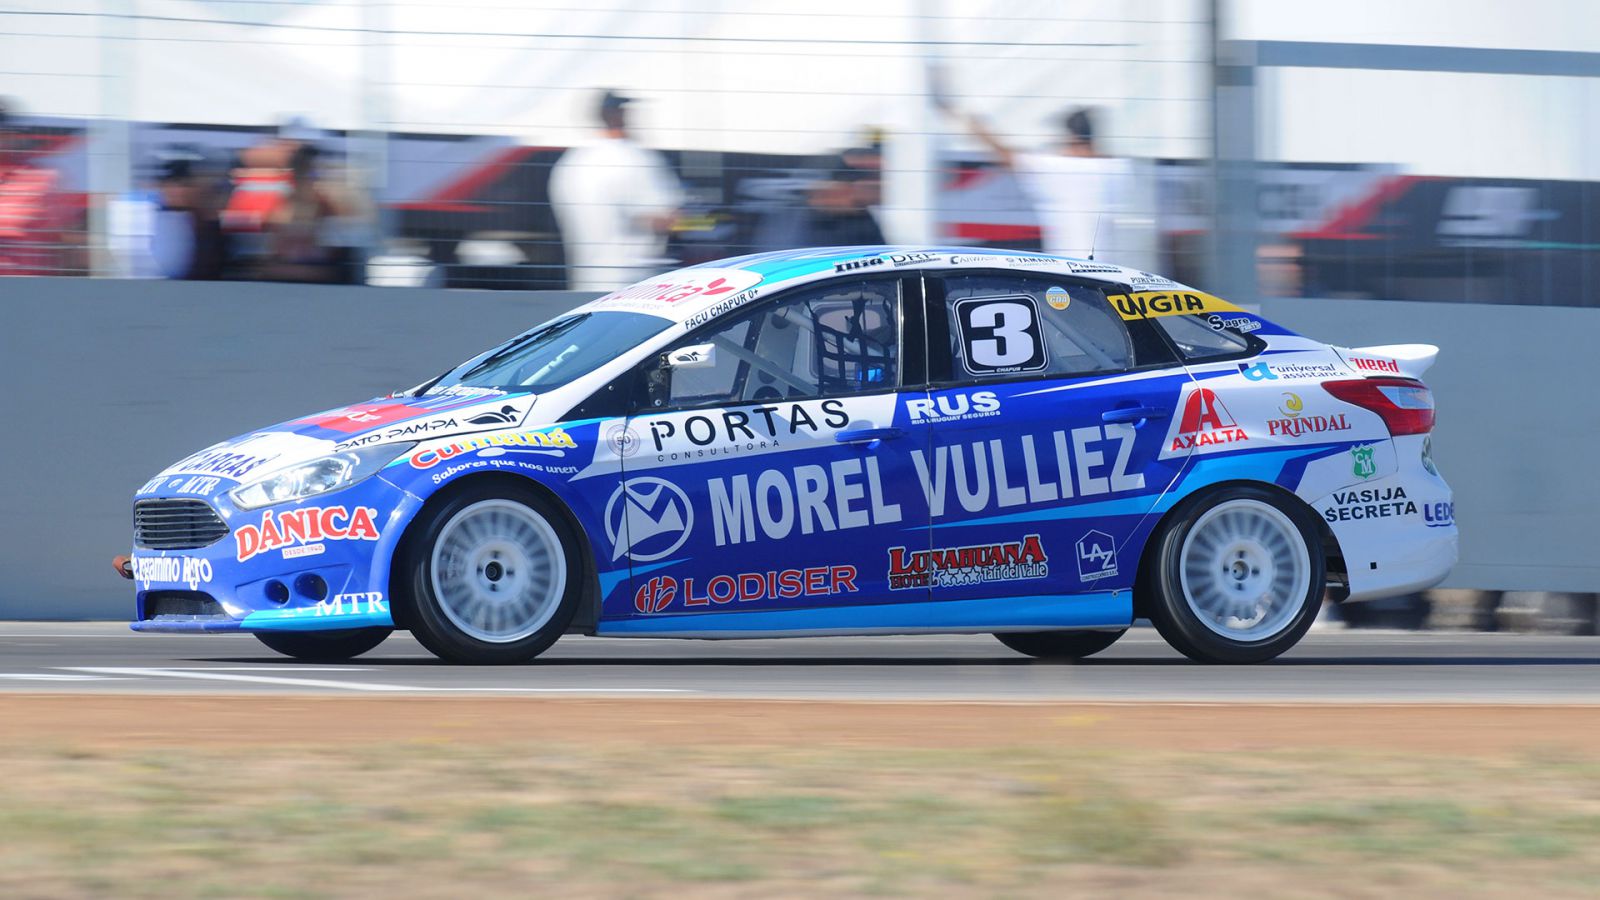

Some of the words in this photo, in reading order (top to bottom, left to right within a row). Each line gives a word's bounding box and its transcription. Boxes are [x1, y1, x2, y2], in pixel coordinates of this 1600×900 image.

[685, 313, 708, 330] FACU
[709, 293, 748, 317] CHAPUR
[1208, 314, 1251, 331] Sagre
[969, 302, 1035, 367] 3
[1276, 363, 1336, 373] universal
[1282, 370, 1350, 380] assistance
[905, 391, 1001, 420] RUS
[926, 415, 961, 424] URUGUAY
[962, 410, 1001, 420] SEGUROS
[335, 433, 381, 453] PATO
[385, 418, 459, 438] PAMPA
[649, 400, 850, 452] PORTAS
[1267, 414, 1351, 437] PRINDAL
[410, 429, 577, 470] Cumaná
[657, 439, 780, 462] CONSULTORA
[1172, 428, 1248, 451] AXALTA
[432, 459, 488, 484] Sabores
[489, 459, 516, 468] que
[519, 462, 543, 472] nos
[546, 465, 578, 474] unen
[708, 455, 901, 547] MOREL
[911, 423, 1145, 518] VULLIEZ
[1333, 487, 1407, 505] VASIJA
[1325, 501, 1418, 522] SECRETA
[235, 506, 379, 561] DÁNICA
[889, 534, 1048, 576] LUNAHUANA
[1080, 542, 1115, 569] LAZ
[131, 551, 180, 590] ergamino
[890, 573, 938, 589] HOTEL
[1001, 565, 1018, 578] del
[1020, 562, 1046, 577] Valle
[684, 564, 858, 607] LODISER
[314, 591, 388, 617] MTR
